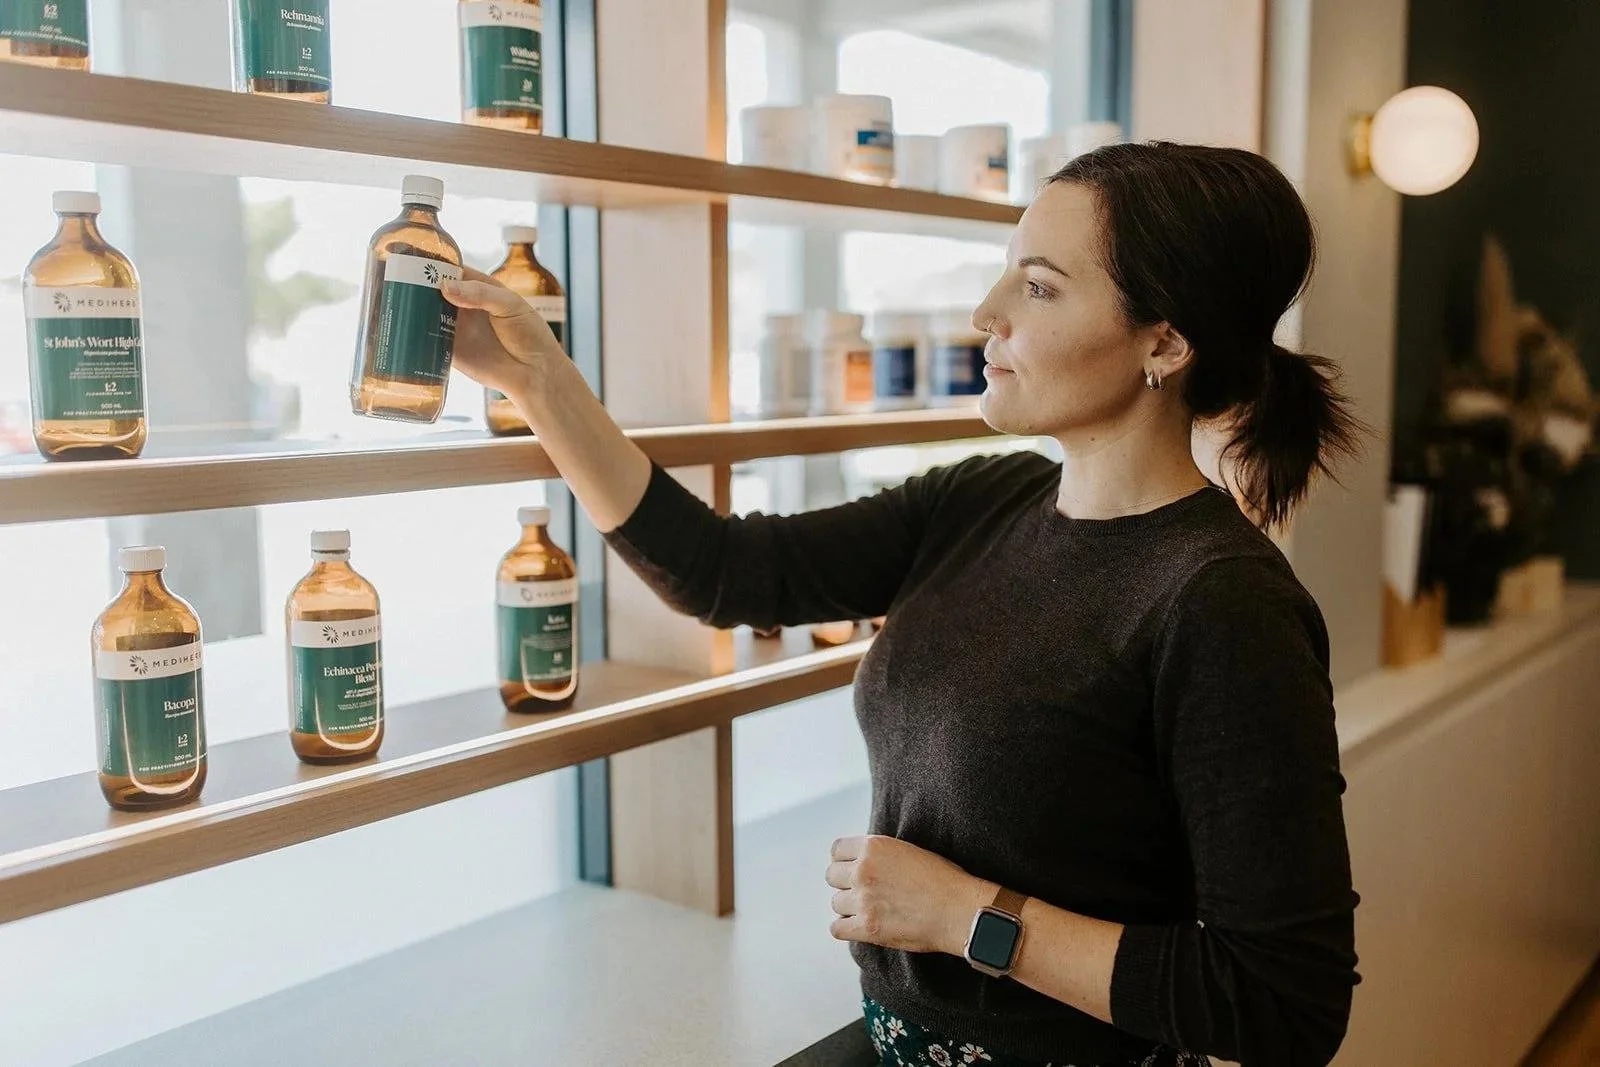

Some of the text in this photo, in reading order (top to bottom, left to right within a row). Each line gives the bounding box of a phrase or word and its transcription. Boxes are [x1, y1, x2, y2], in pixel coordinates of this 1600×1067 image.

[281, 9, 325, 25] Rehmannia
[302, 47, 312, 56] 1:2
[44, 337, 54, 348] St
[55, 336, 86, 349] John's
[86, 336, 114, 348] Wort
[105, 382, 117, 391] 1:2
[323, 666, 365, 677] Echinacea
[355, 672, 375, 684] Blend
[164, 698, 195, 711] Bacopa
[178, 734, 188, 744] 1:2
